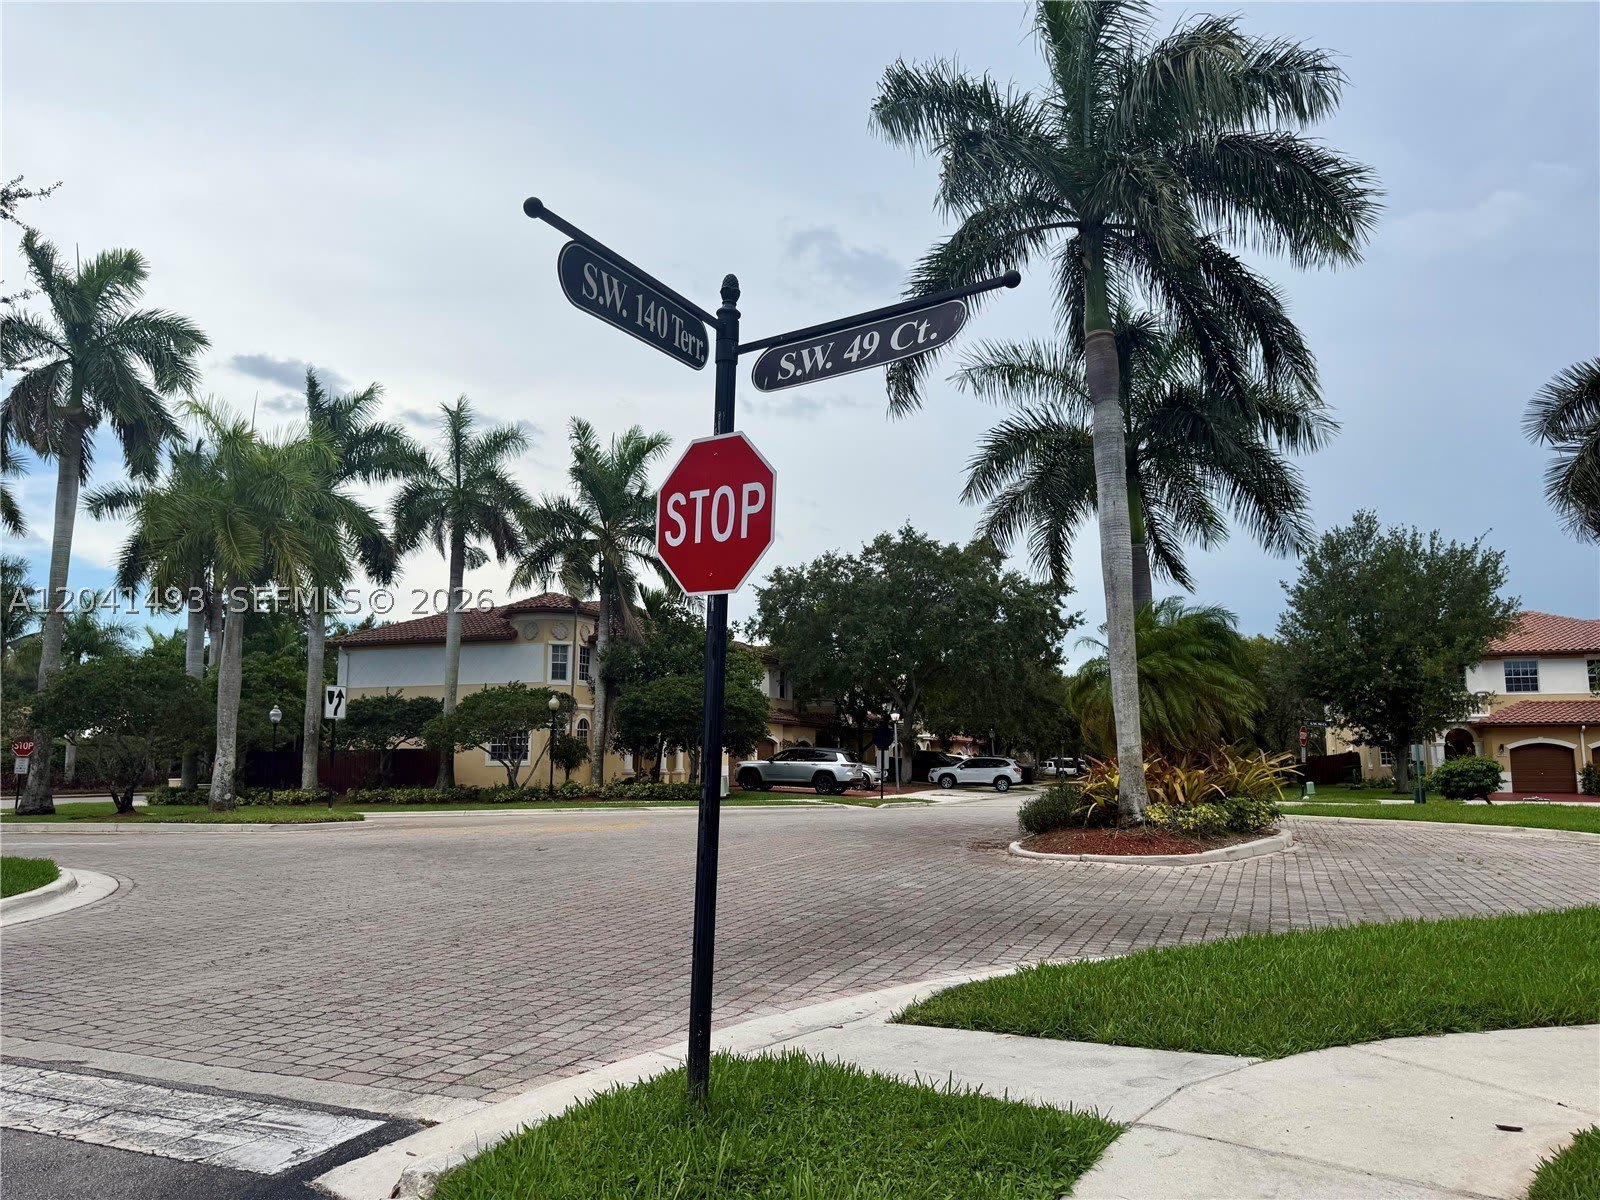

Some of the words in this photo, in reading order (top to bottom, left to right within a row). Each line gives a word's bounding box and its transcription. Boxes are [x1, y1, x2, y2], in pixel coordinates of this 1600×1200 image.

[582, 262, 628, 318] S.W.
[635, 294, 668, 339] 140
[671, 313, 705, 363] Terr.
[777, 341, 835, 381] S.W.
[843, 331, 881, 363] 49
[890, 318, 938, 351] Ct.
[664, 481, 766, 547] STOP
